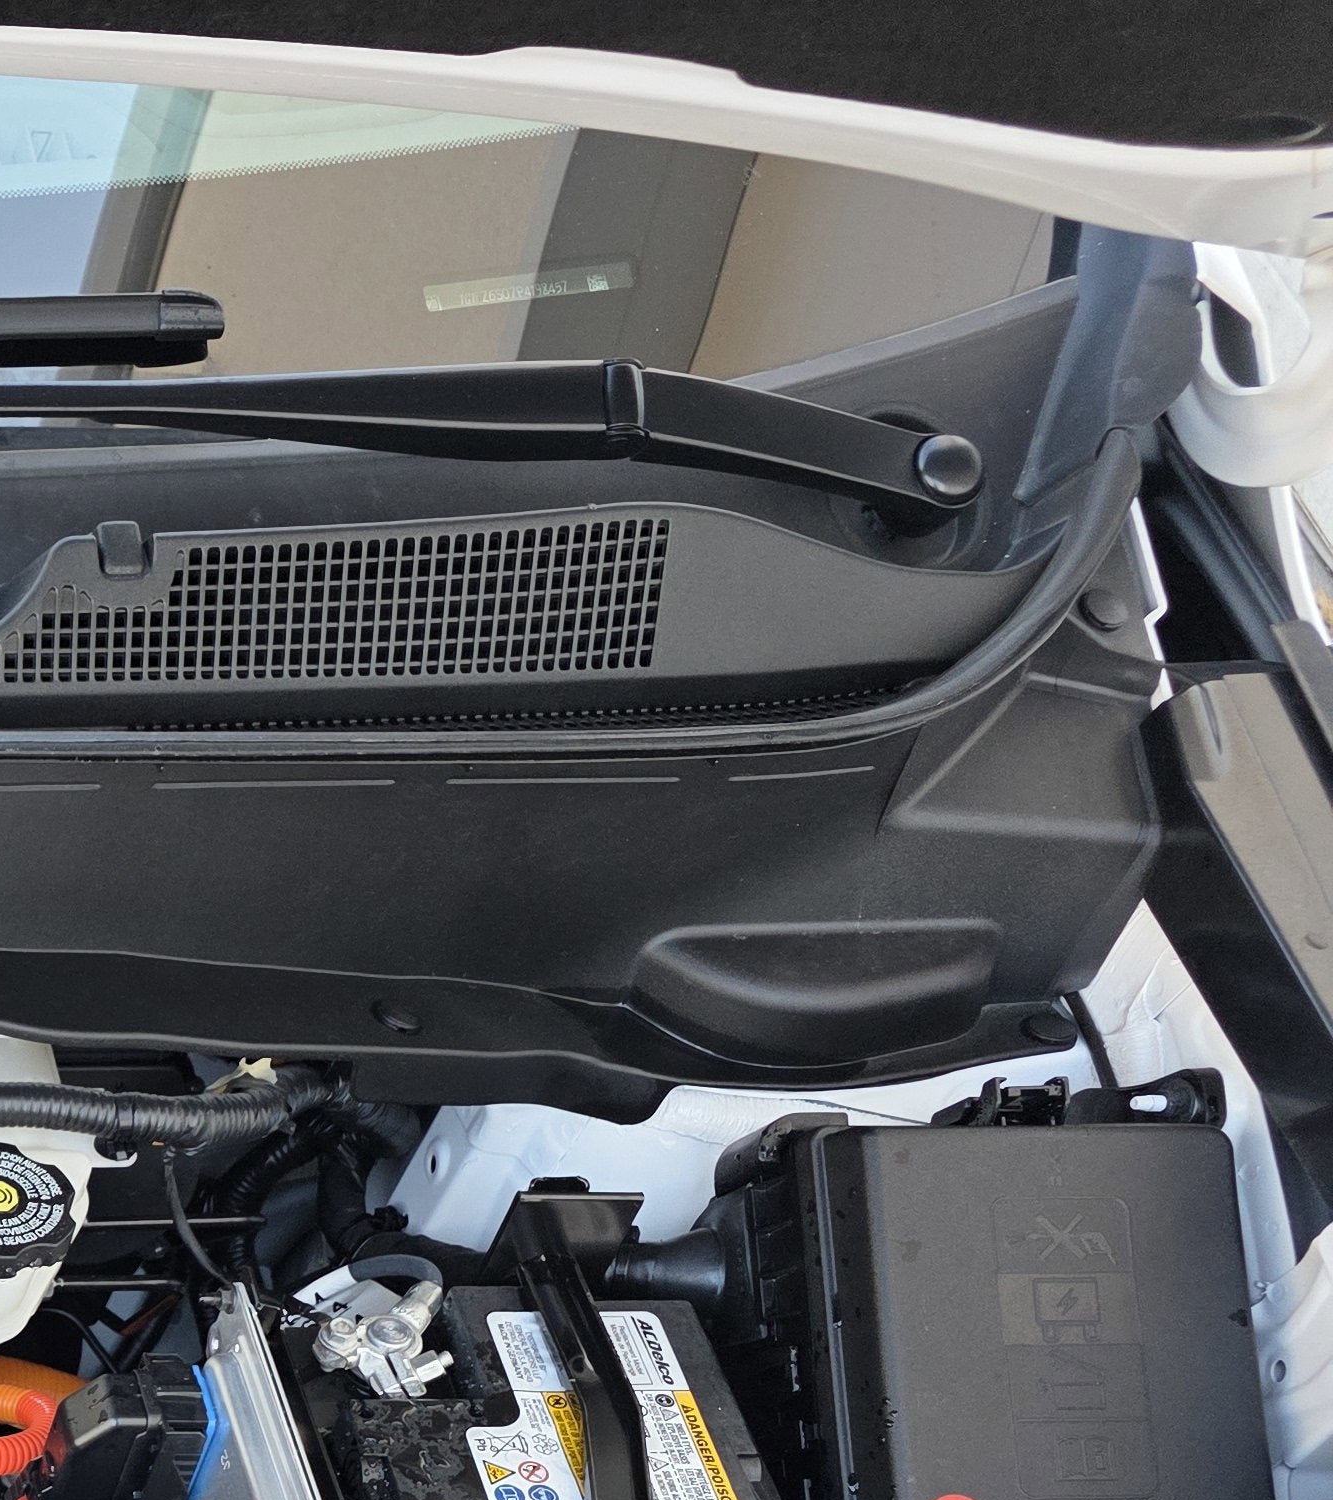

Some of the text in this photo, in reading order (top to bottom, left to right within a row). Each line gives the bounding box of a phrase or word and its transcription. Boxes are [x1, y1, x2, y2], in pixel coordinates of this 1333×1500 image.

[3, 1233, 38, 1246] SEALED
[636, 1318, 674, 1384] ACDelco
[474, 1437, 487, 1451] Pb
